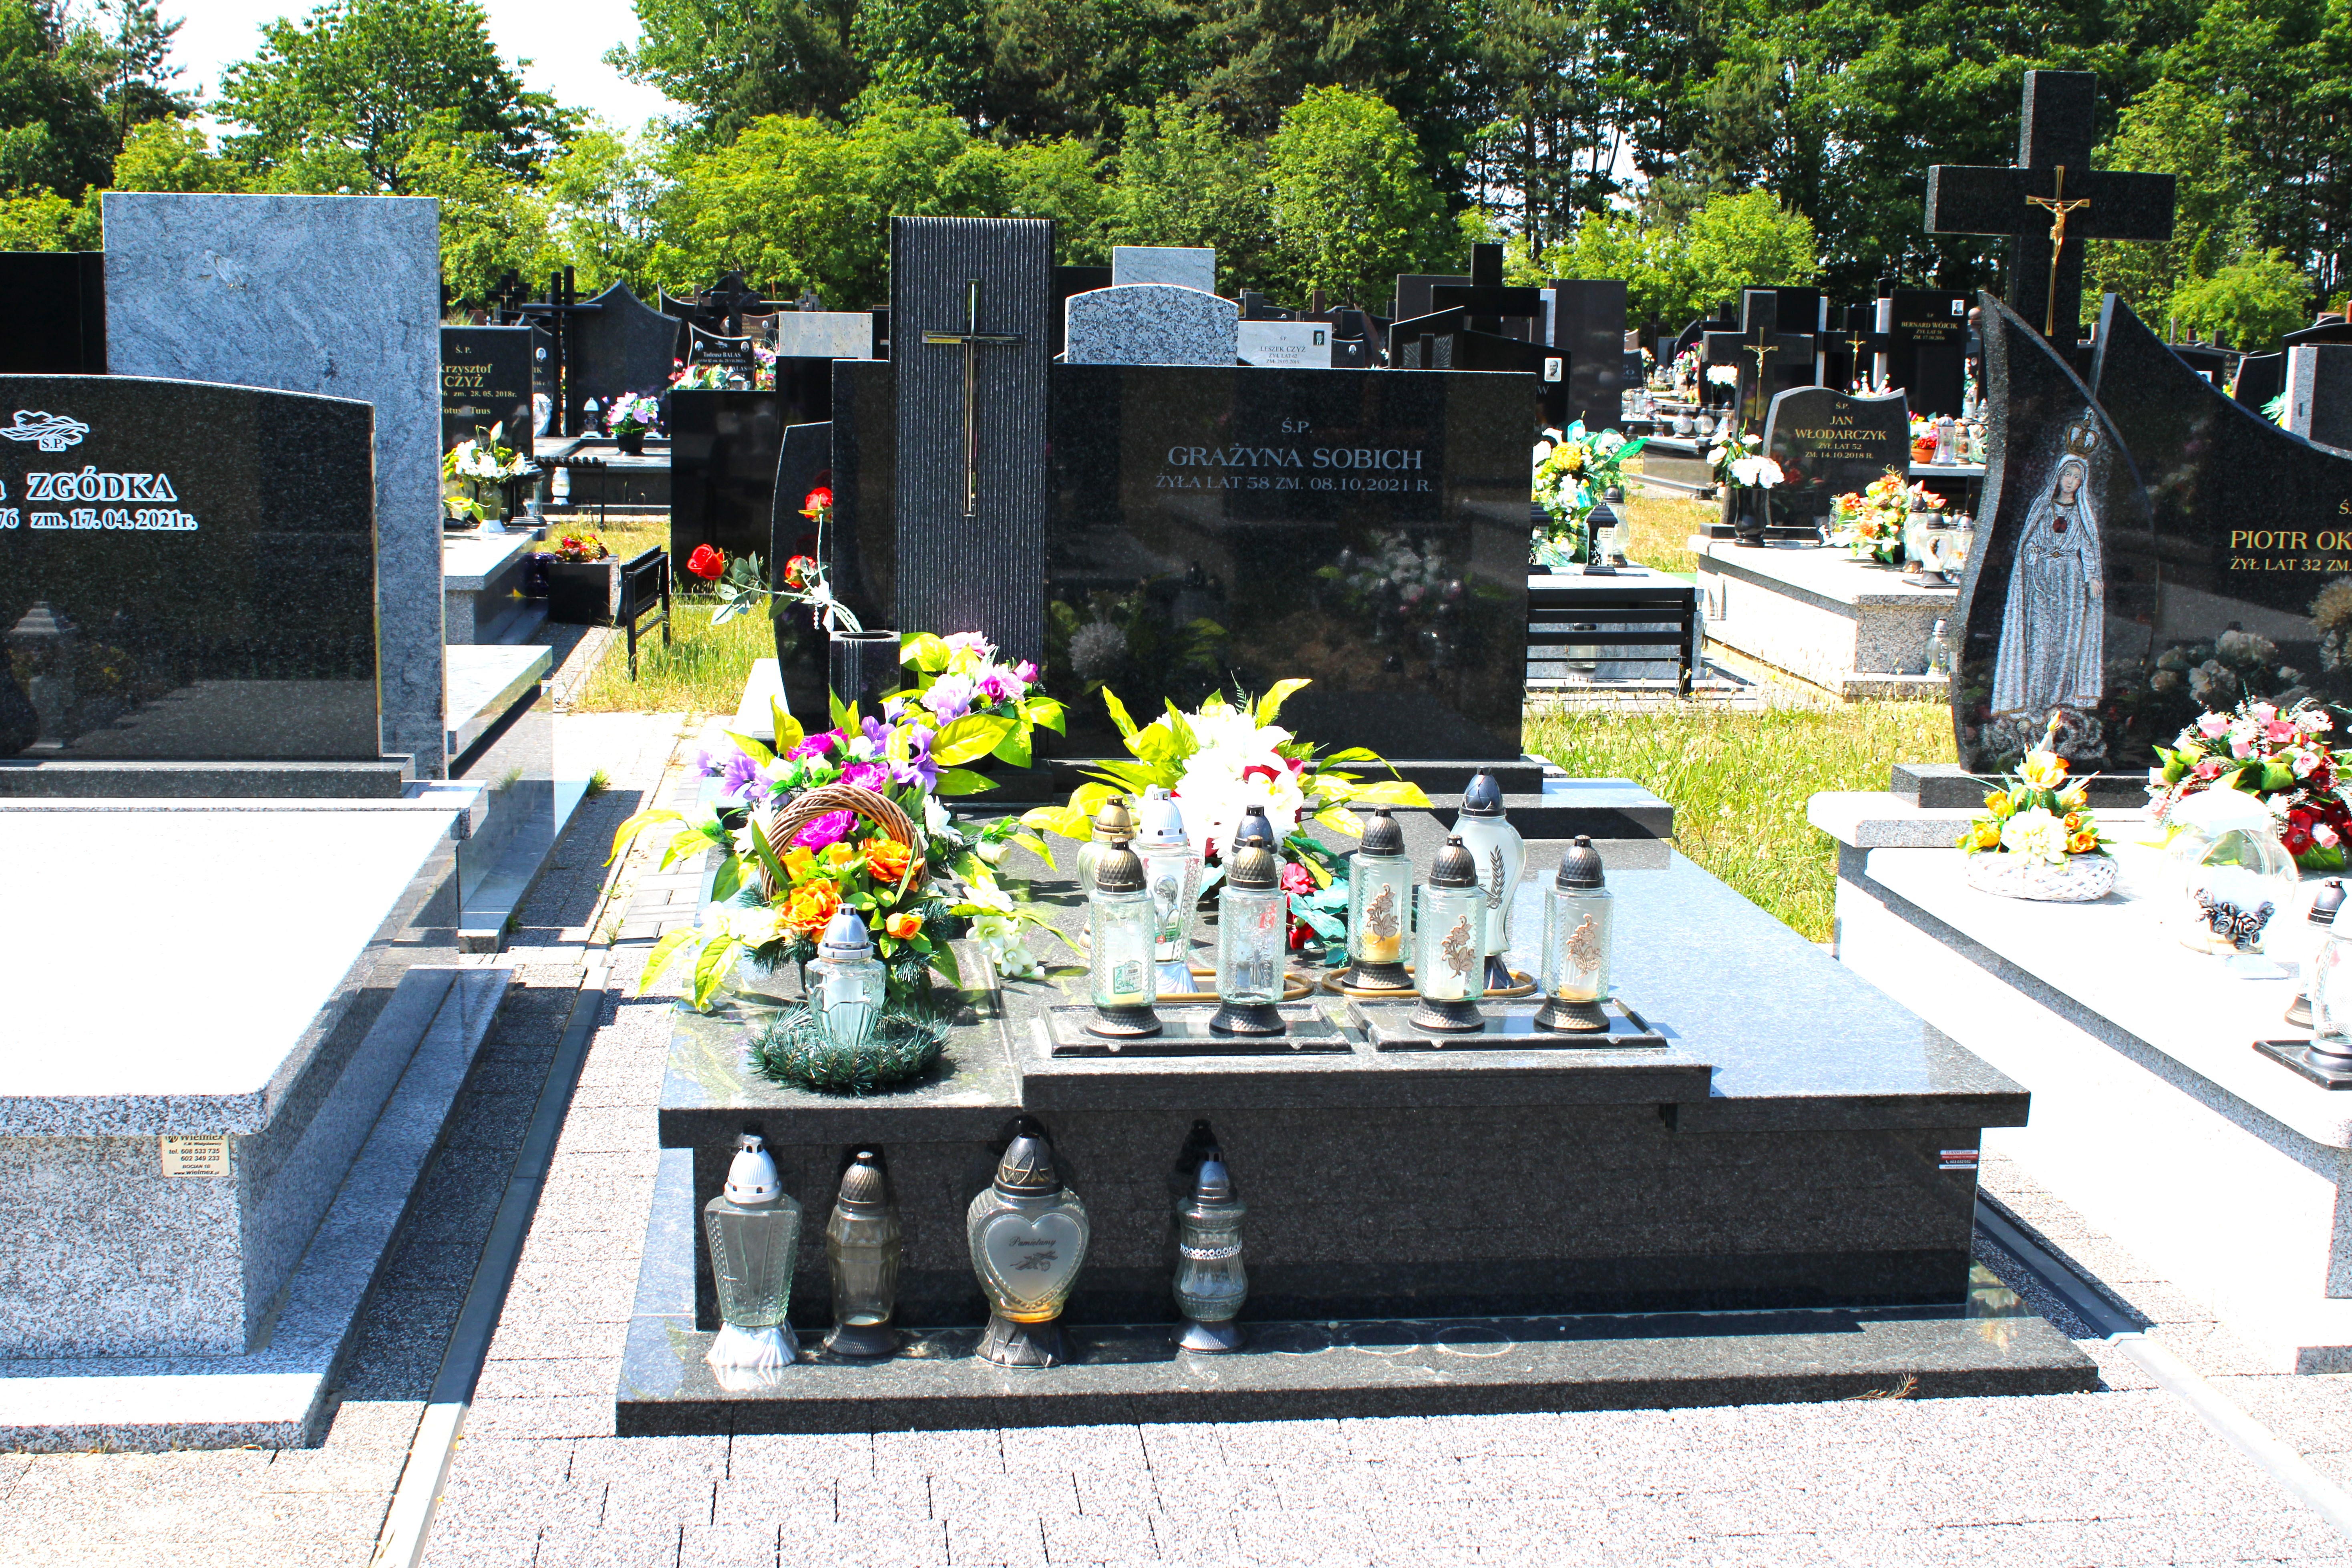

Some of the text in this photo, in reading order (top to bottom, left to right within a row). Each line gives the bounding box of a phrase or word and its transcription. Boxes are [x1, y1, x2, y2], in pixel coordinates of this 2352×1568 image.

[1932, 321, 1958, 329] WÓJCIK
[1286, 345, 1306, 353] CZYŻ
[444, 374, 484, 387] CZYŻ
[470, 406, 491, 414] Tuus
[1282, 417, 1313, 433] Ś.P.
[1830, 416, 1853, 425] JAN
[1795, 429, 1887, 440] WŁODARCZYK
[1168, 442, 1423, 469] GRAŻYNA SOBICH
[26, 465, 178, 502] ZGÓDKA
[1156, 472, 1433, 492] ŻYŁA LAT 58 ZM. 08.10.2021 R.
[30, 513, 69, 529] zm.
[2229, 530, 2308, 550] PIOTR
[2229, 555, 2352, 571] ŻYŁ LAT 32 ZM.
